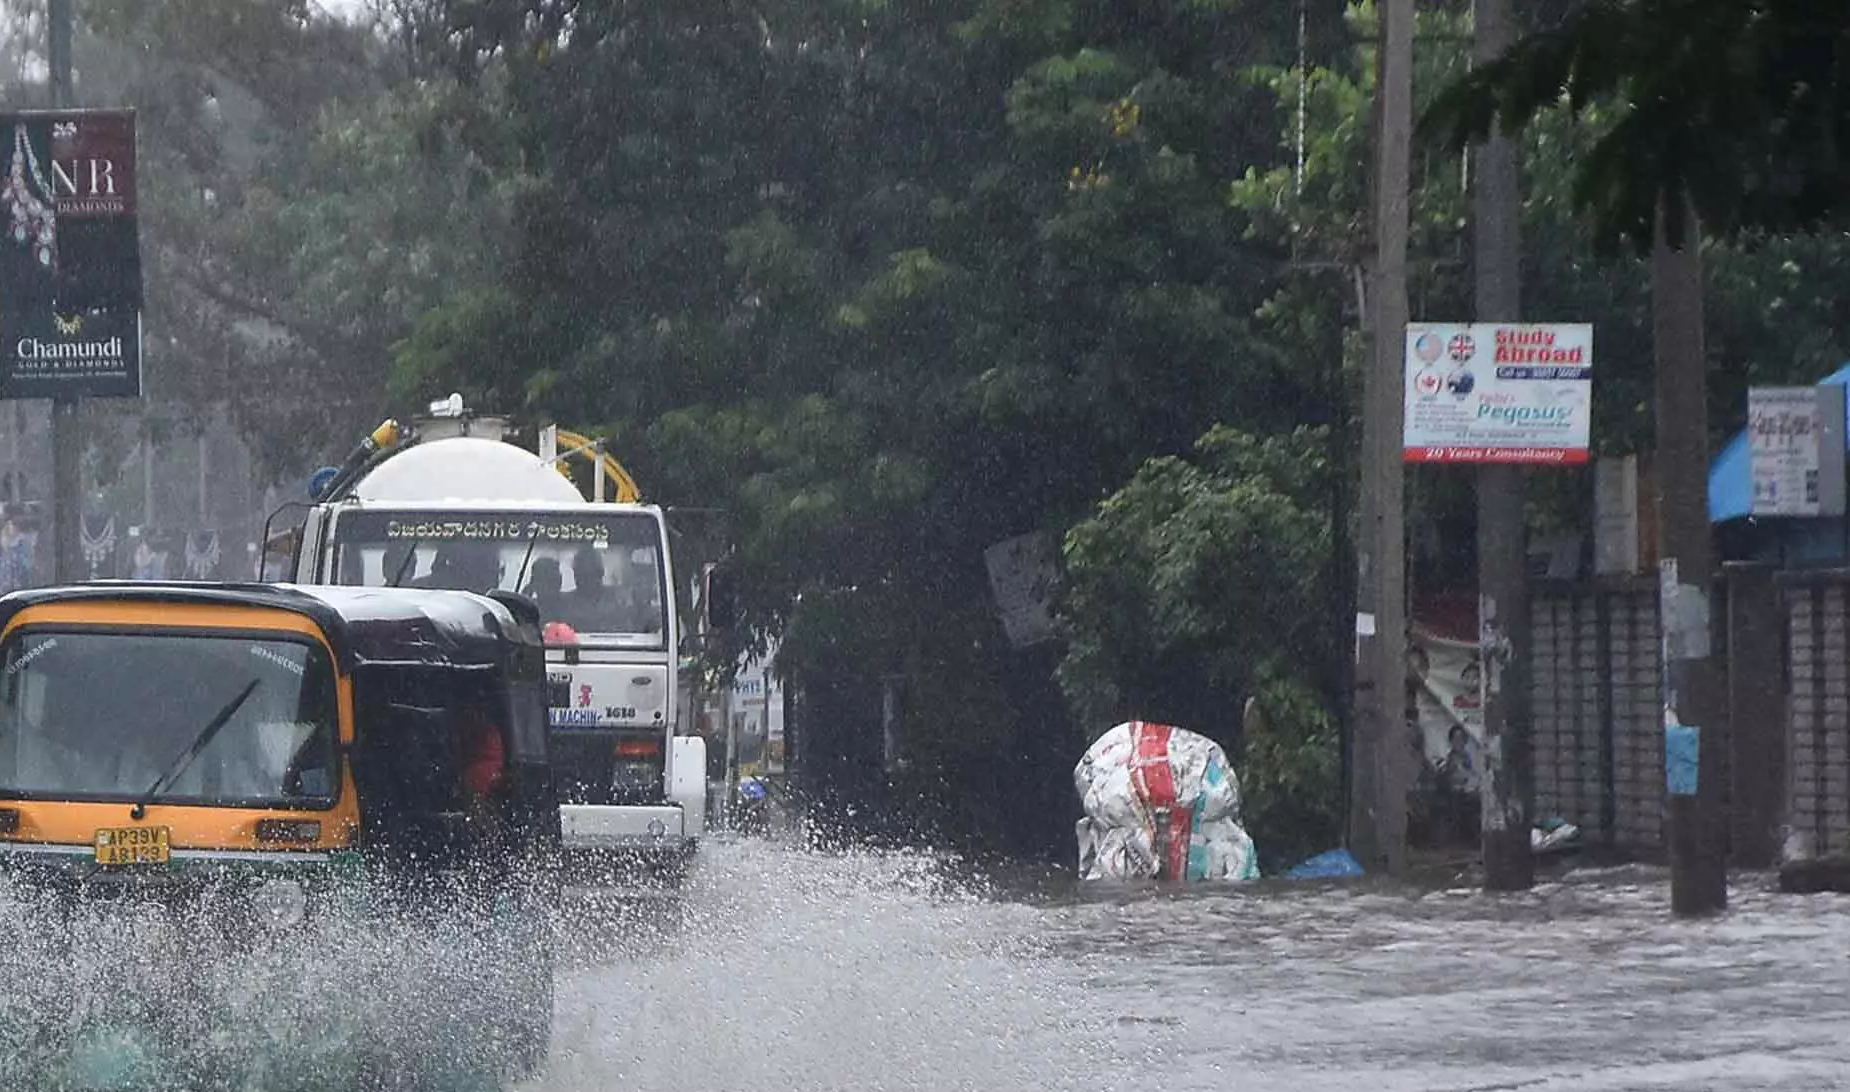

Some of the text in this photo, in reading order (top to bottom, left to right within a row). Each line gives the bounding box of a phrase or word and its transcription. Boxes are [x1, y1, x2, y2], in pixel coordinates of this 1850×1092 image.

[57, 202, 124, 213] DIAMONDS
[1494, 329, 1555, 345] Study
[17, 336, 121, 359] Chamundi
[1495, 345, 1582, 363] Abroad
[1477, 401, 1570, 424] Pegasus
[1485, 446, 1565, 461] Consultancy
[109, 828, 160, 846] AP39V
